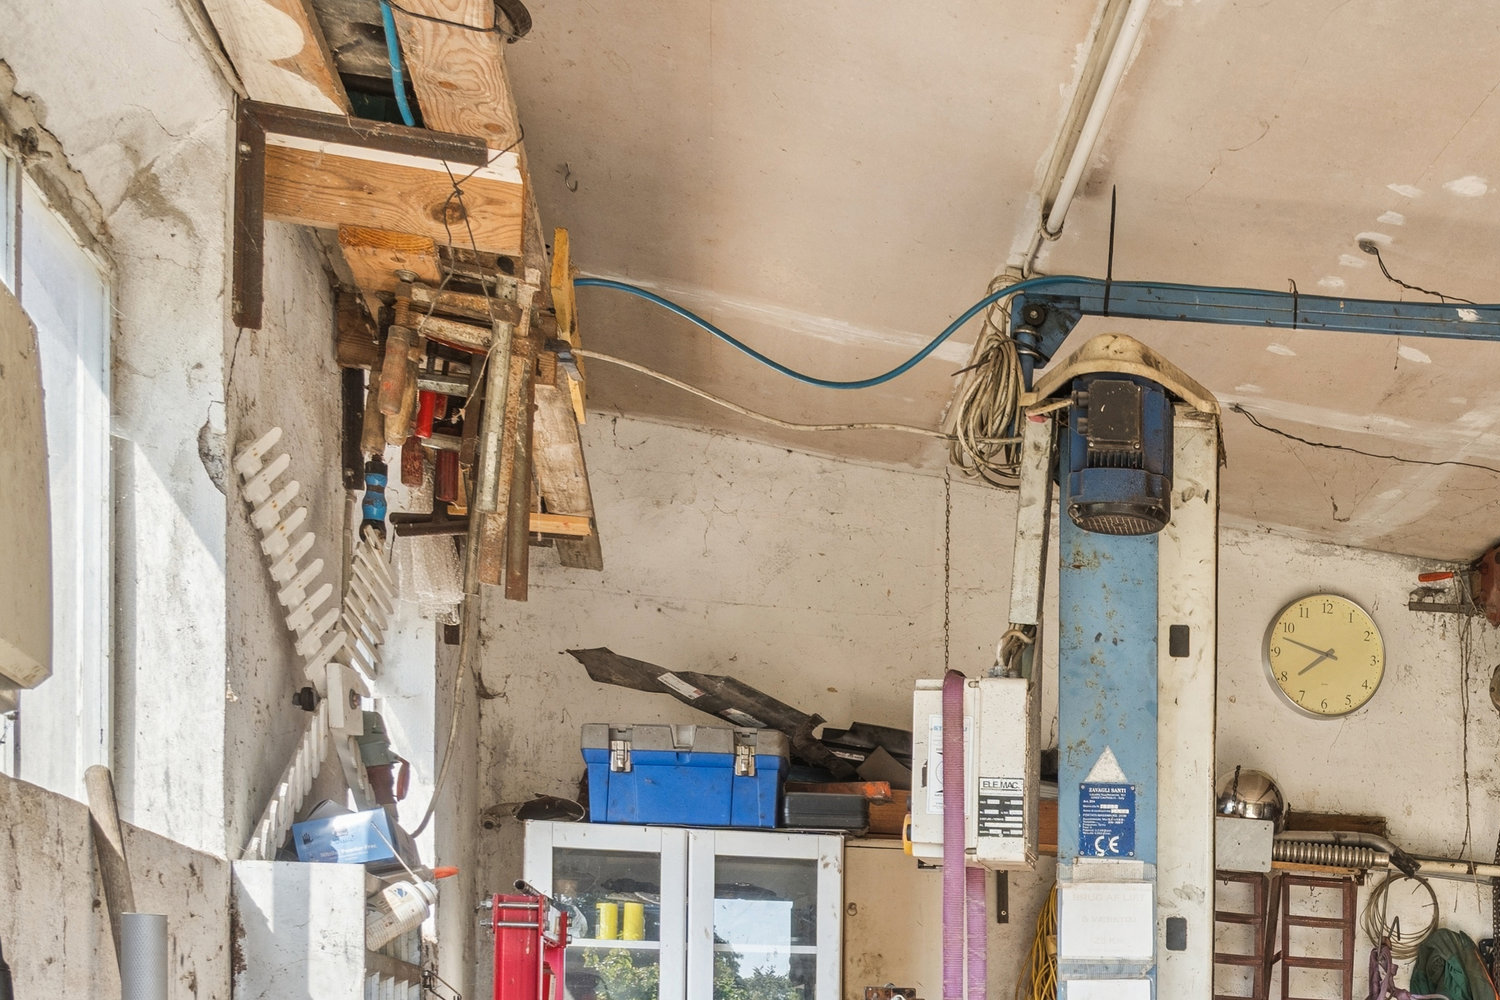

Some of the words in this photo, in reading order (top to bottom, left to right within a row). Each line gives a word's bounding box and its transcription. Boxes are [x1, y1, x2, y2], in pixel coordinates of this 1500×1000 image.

[1300, 607, 1309, 618] 11
[1322, 603, 1334, 614] 12
[1349, 612, 1353, 623] 1
[1283, 622, 1295, 633] 10
[1363, 631, 1371, 641] 2
[1274, 647, 1281, 657] 9
[1370, 655, 1377, 666] 3
[1281, 671, 1288, 682] 8
[1361, 680, 1368, 690] 4
[1299, 690, 1306, 701] 7
[1345, 695, 1352, 706] 5
[1321, 698, 1328, 709] 6
[1094, 836, 1119, 854] CE
